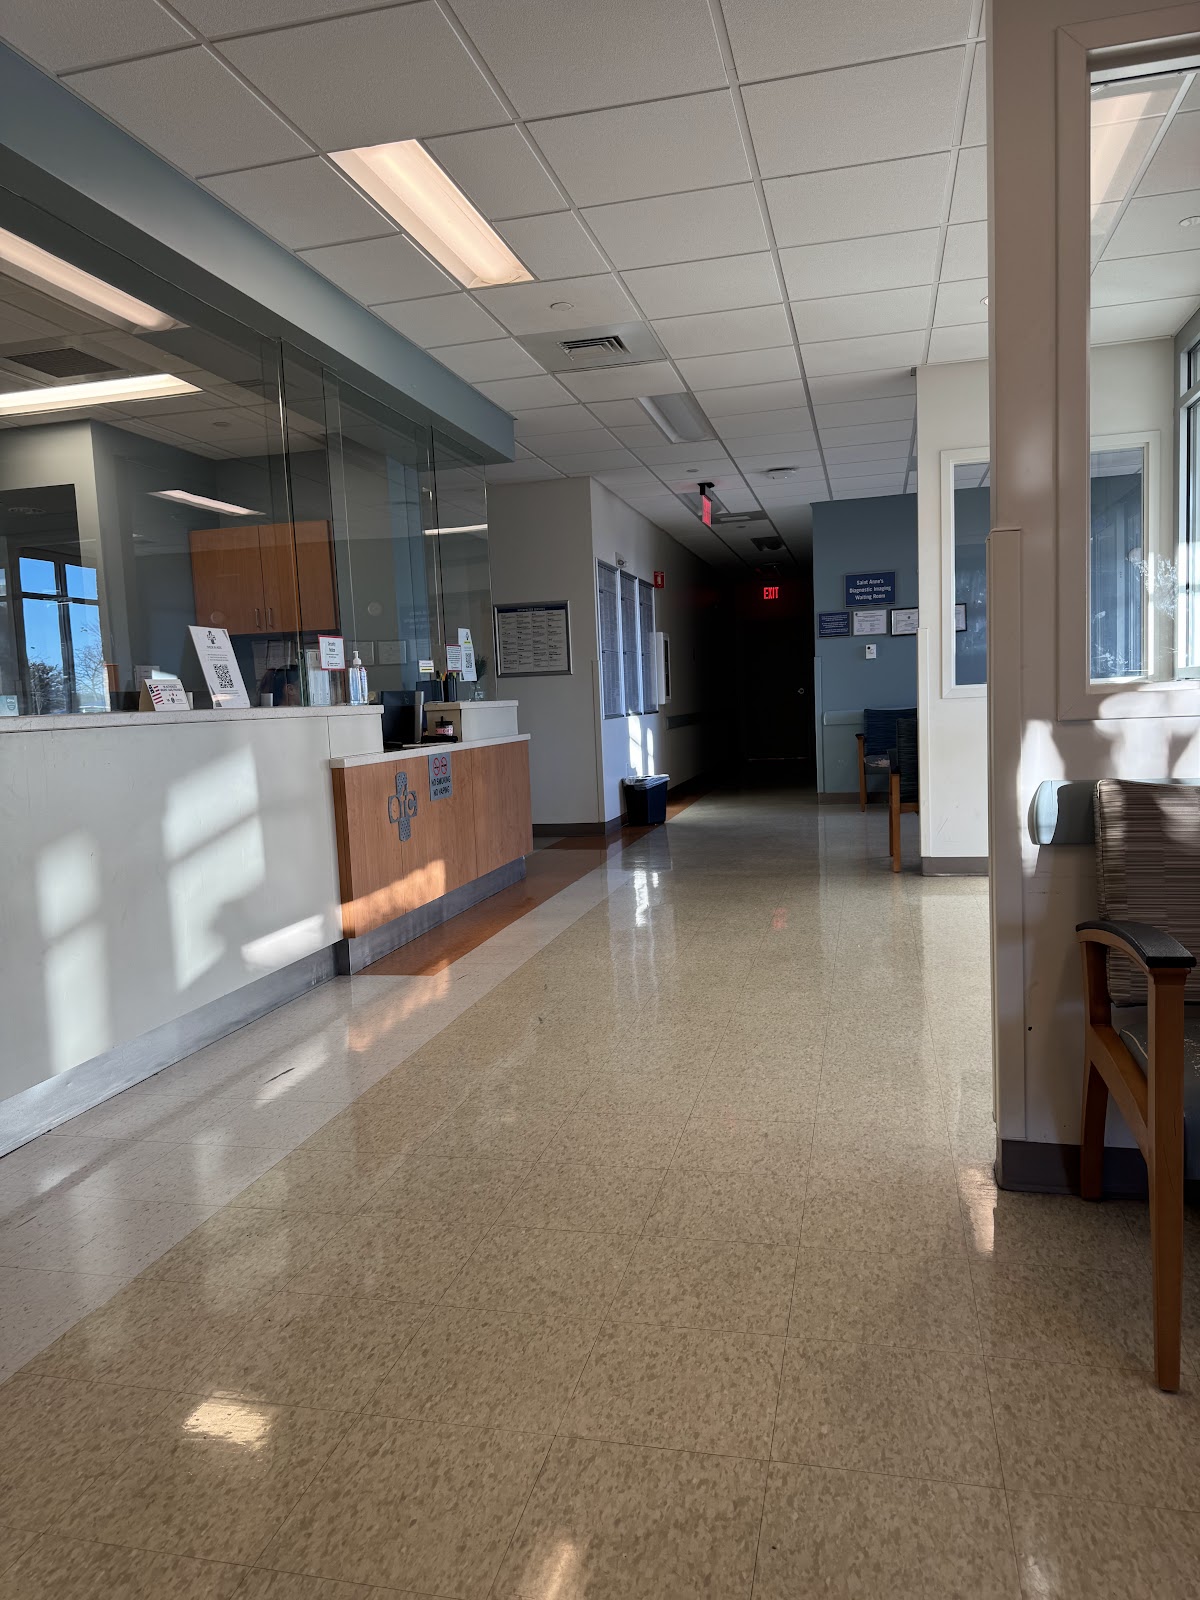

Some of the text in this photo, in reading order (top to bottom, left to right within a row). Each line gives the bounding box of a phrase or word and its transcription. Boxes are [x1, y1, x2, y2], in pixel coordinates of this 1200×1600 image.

[763, 587, 779, 600] EXIT
[437, 776, 450, 785] SMOKING
[433, 786, 450, 797] NO VAPING
